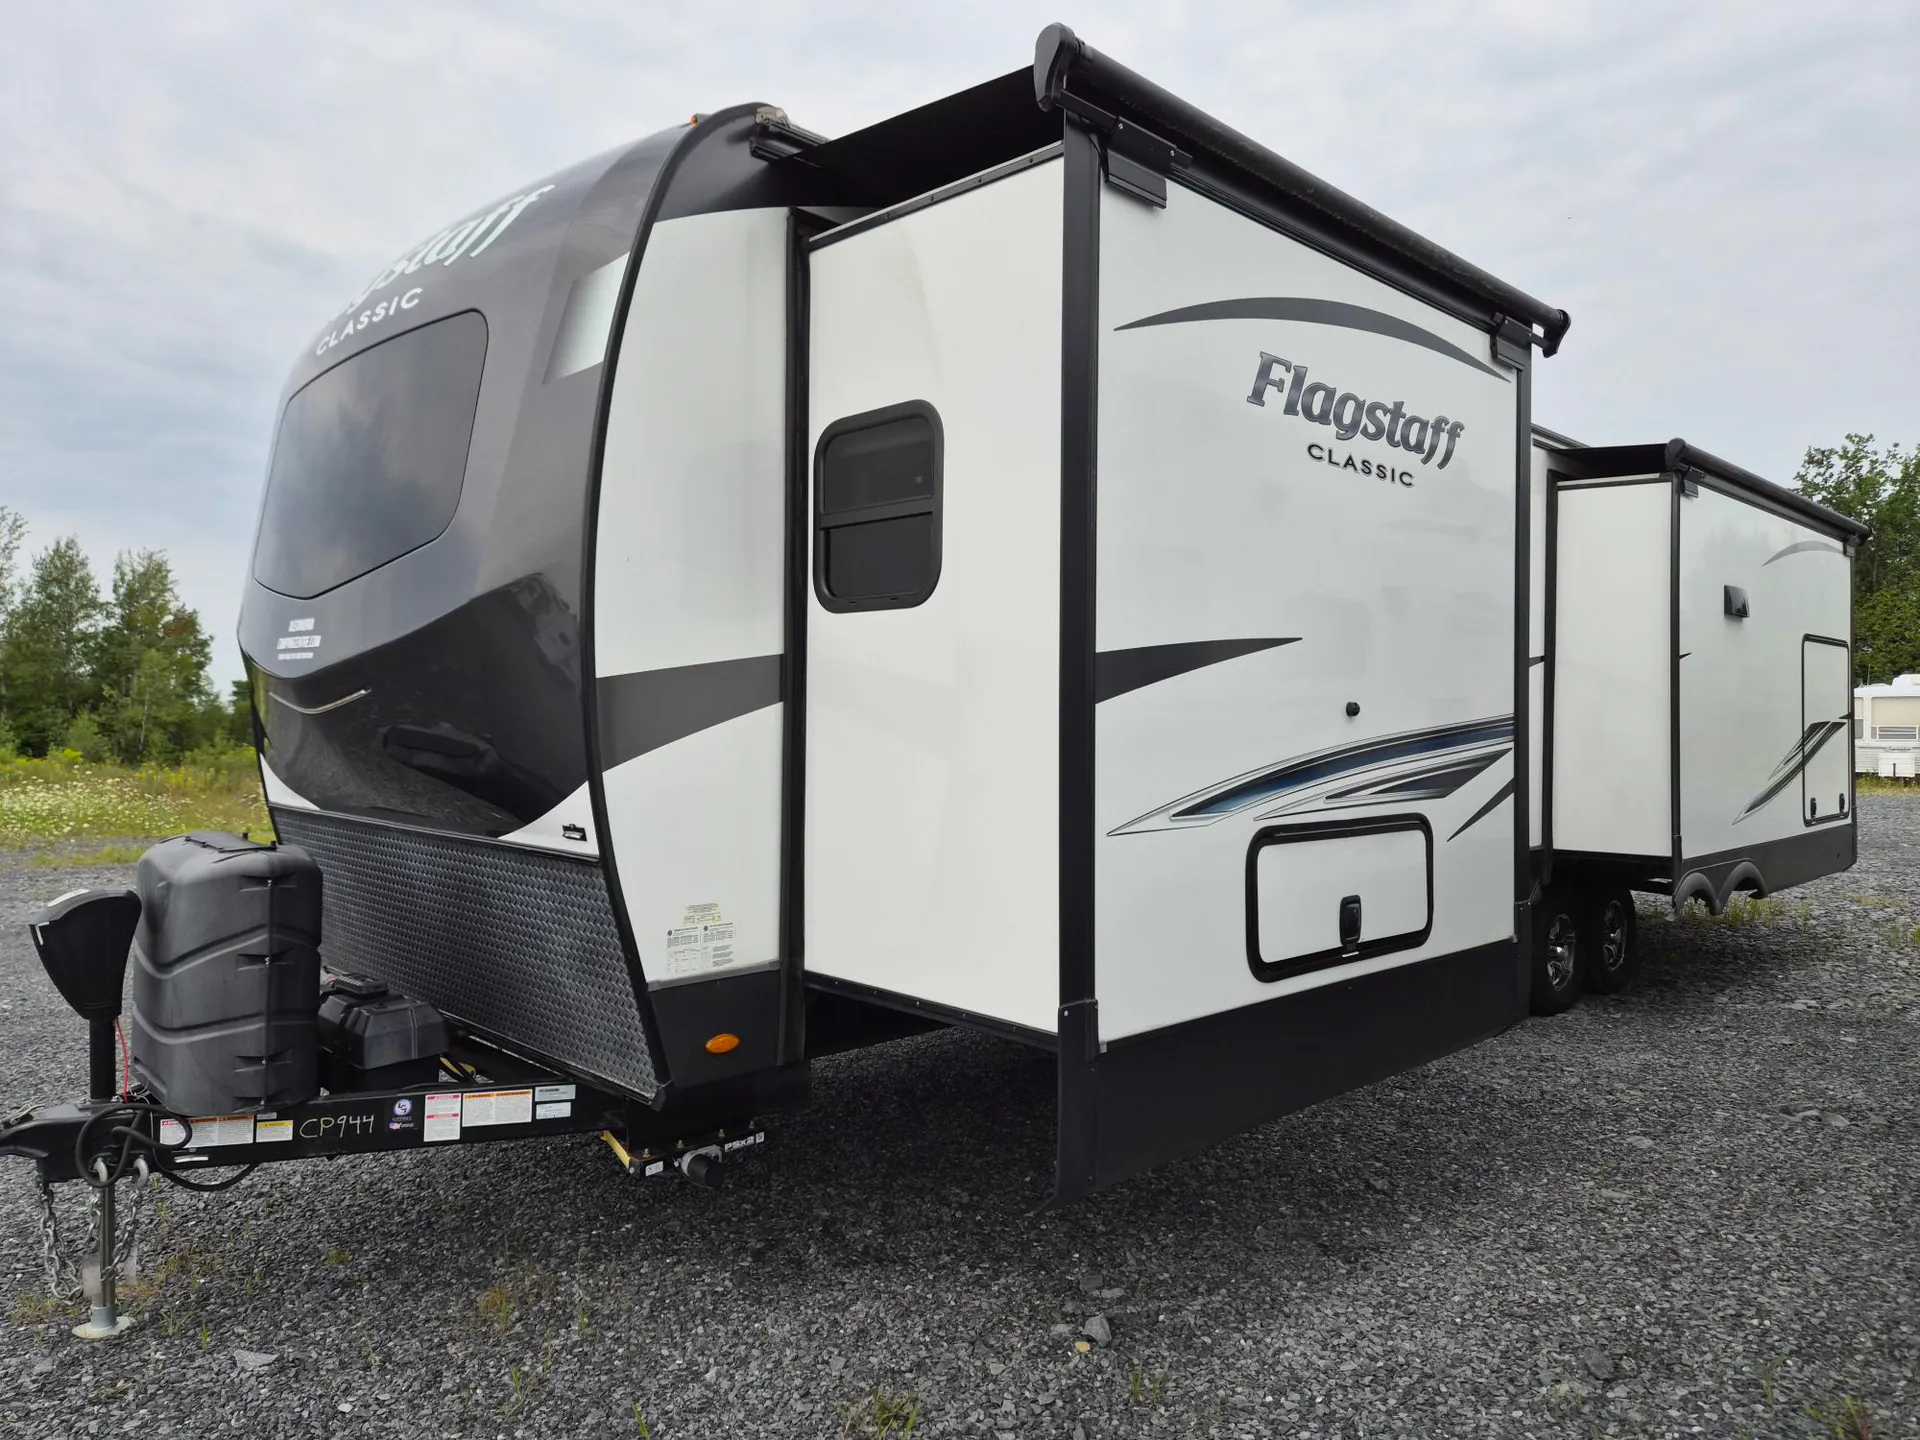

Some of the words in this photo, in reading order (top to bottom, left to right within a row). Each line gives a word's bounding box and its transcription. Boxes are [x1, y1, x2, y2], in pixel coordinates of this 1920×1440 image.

[340, 184, 556, 316] staff
[315, 288, 423, 356] CLASSIC
[1246, 351, 1465, 470] Flagstaff
[1306, 443, 1415, 487] CLASSIC
[299, 1114, 375, 1138] CP944
